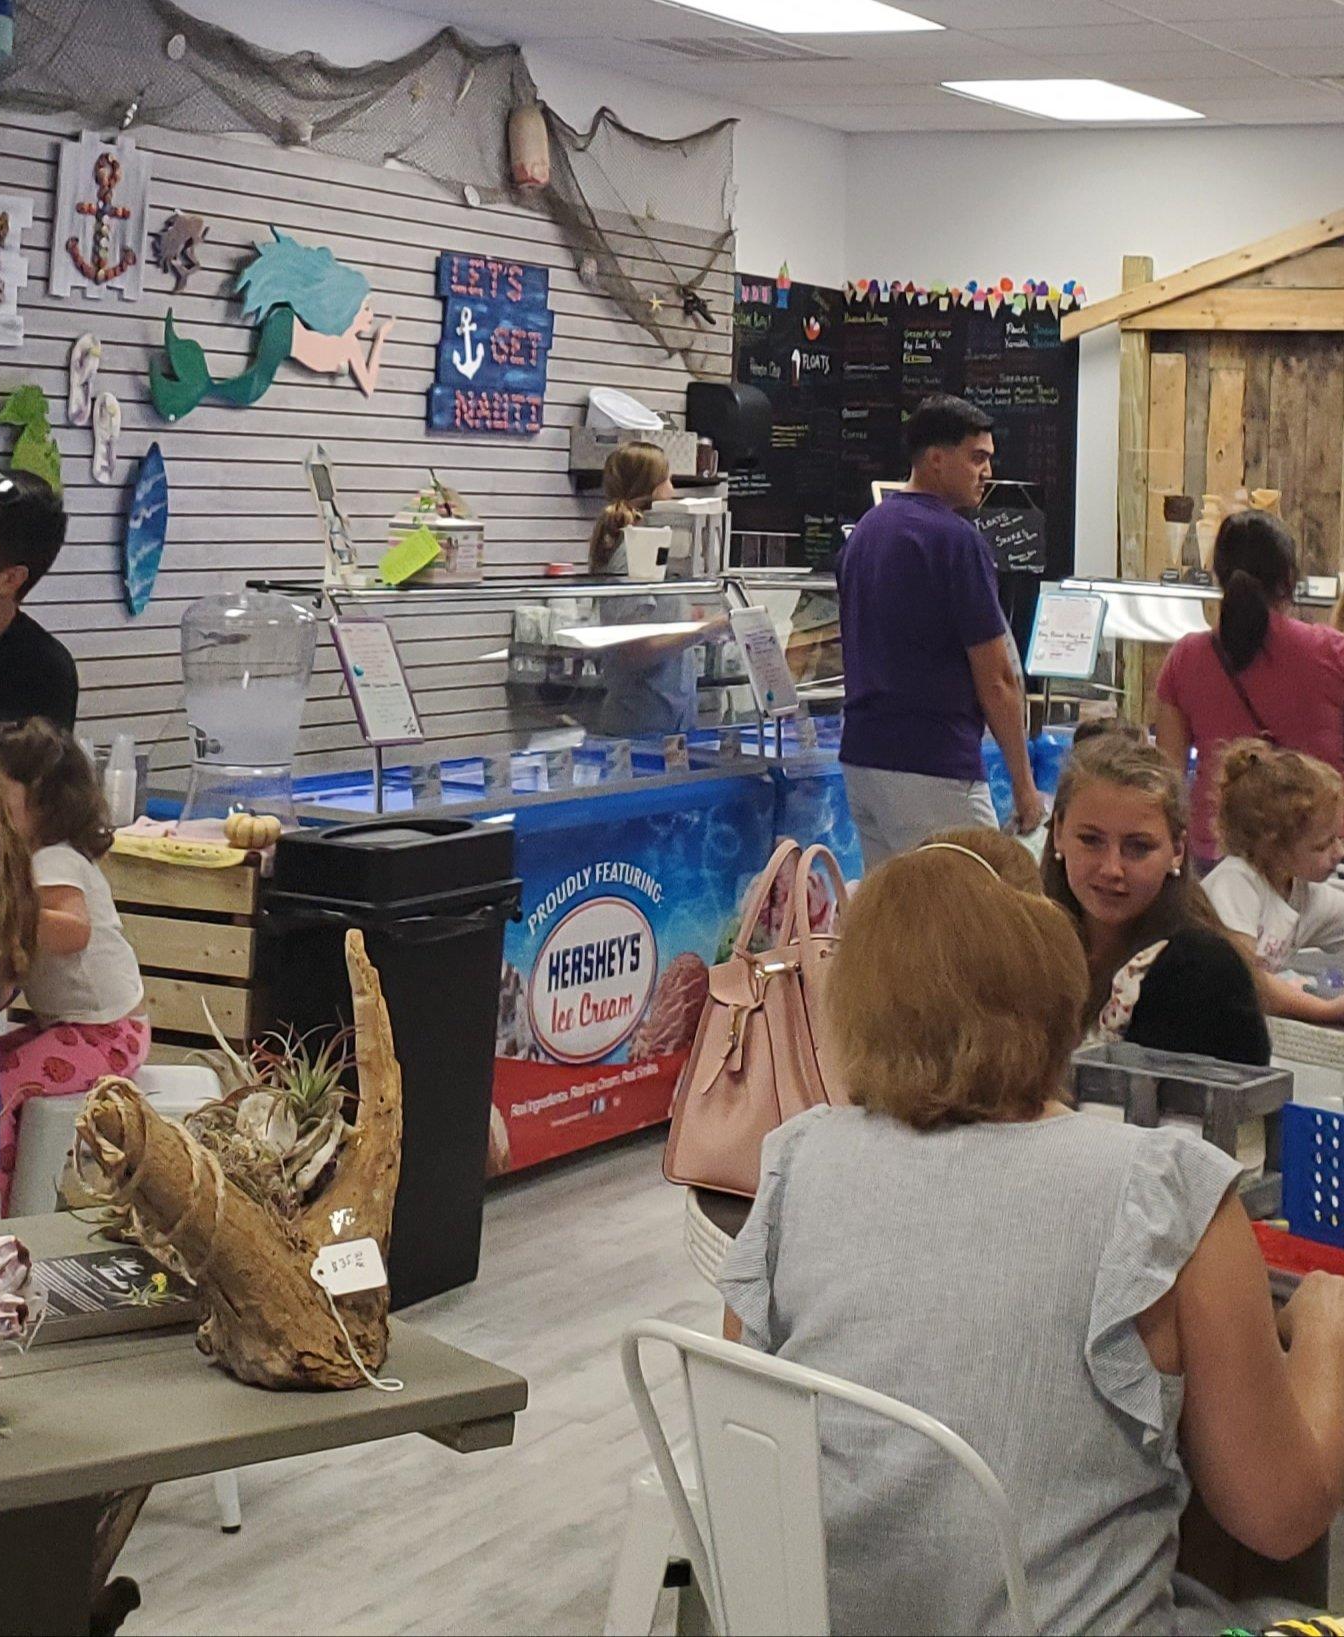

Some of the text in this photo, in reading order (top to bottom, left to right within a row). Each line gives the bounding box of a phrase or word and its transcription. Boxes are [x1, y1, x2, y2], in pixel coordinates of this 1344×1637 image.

[450, 256, 524, 303] LET'S
[489, 326, 543, 367] GET
[801, 352, 831, 375] FLOATS
[454, 388, 542, 432] NAUTI
[974, 512, 1009, 531] FLOATS
[528, 868, 591, 935] PROUDLY
[547, 933, 641, 993] HERSHEY'S
[552, 992, 633, 1034] Ice Cream
